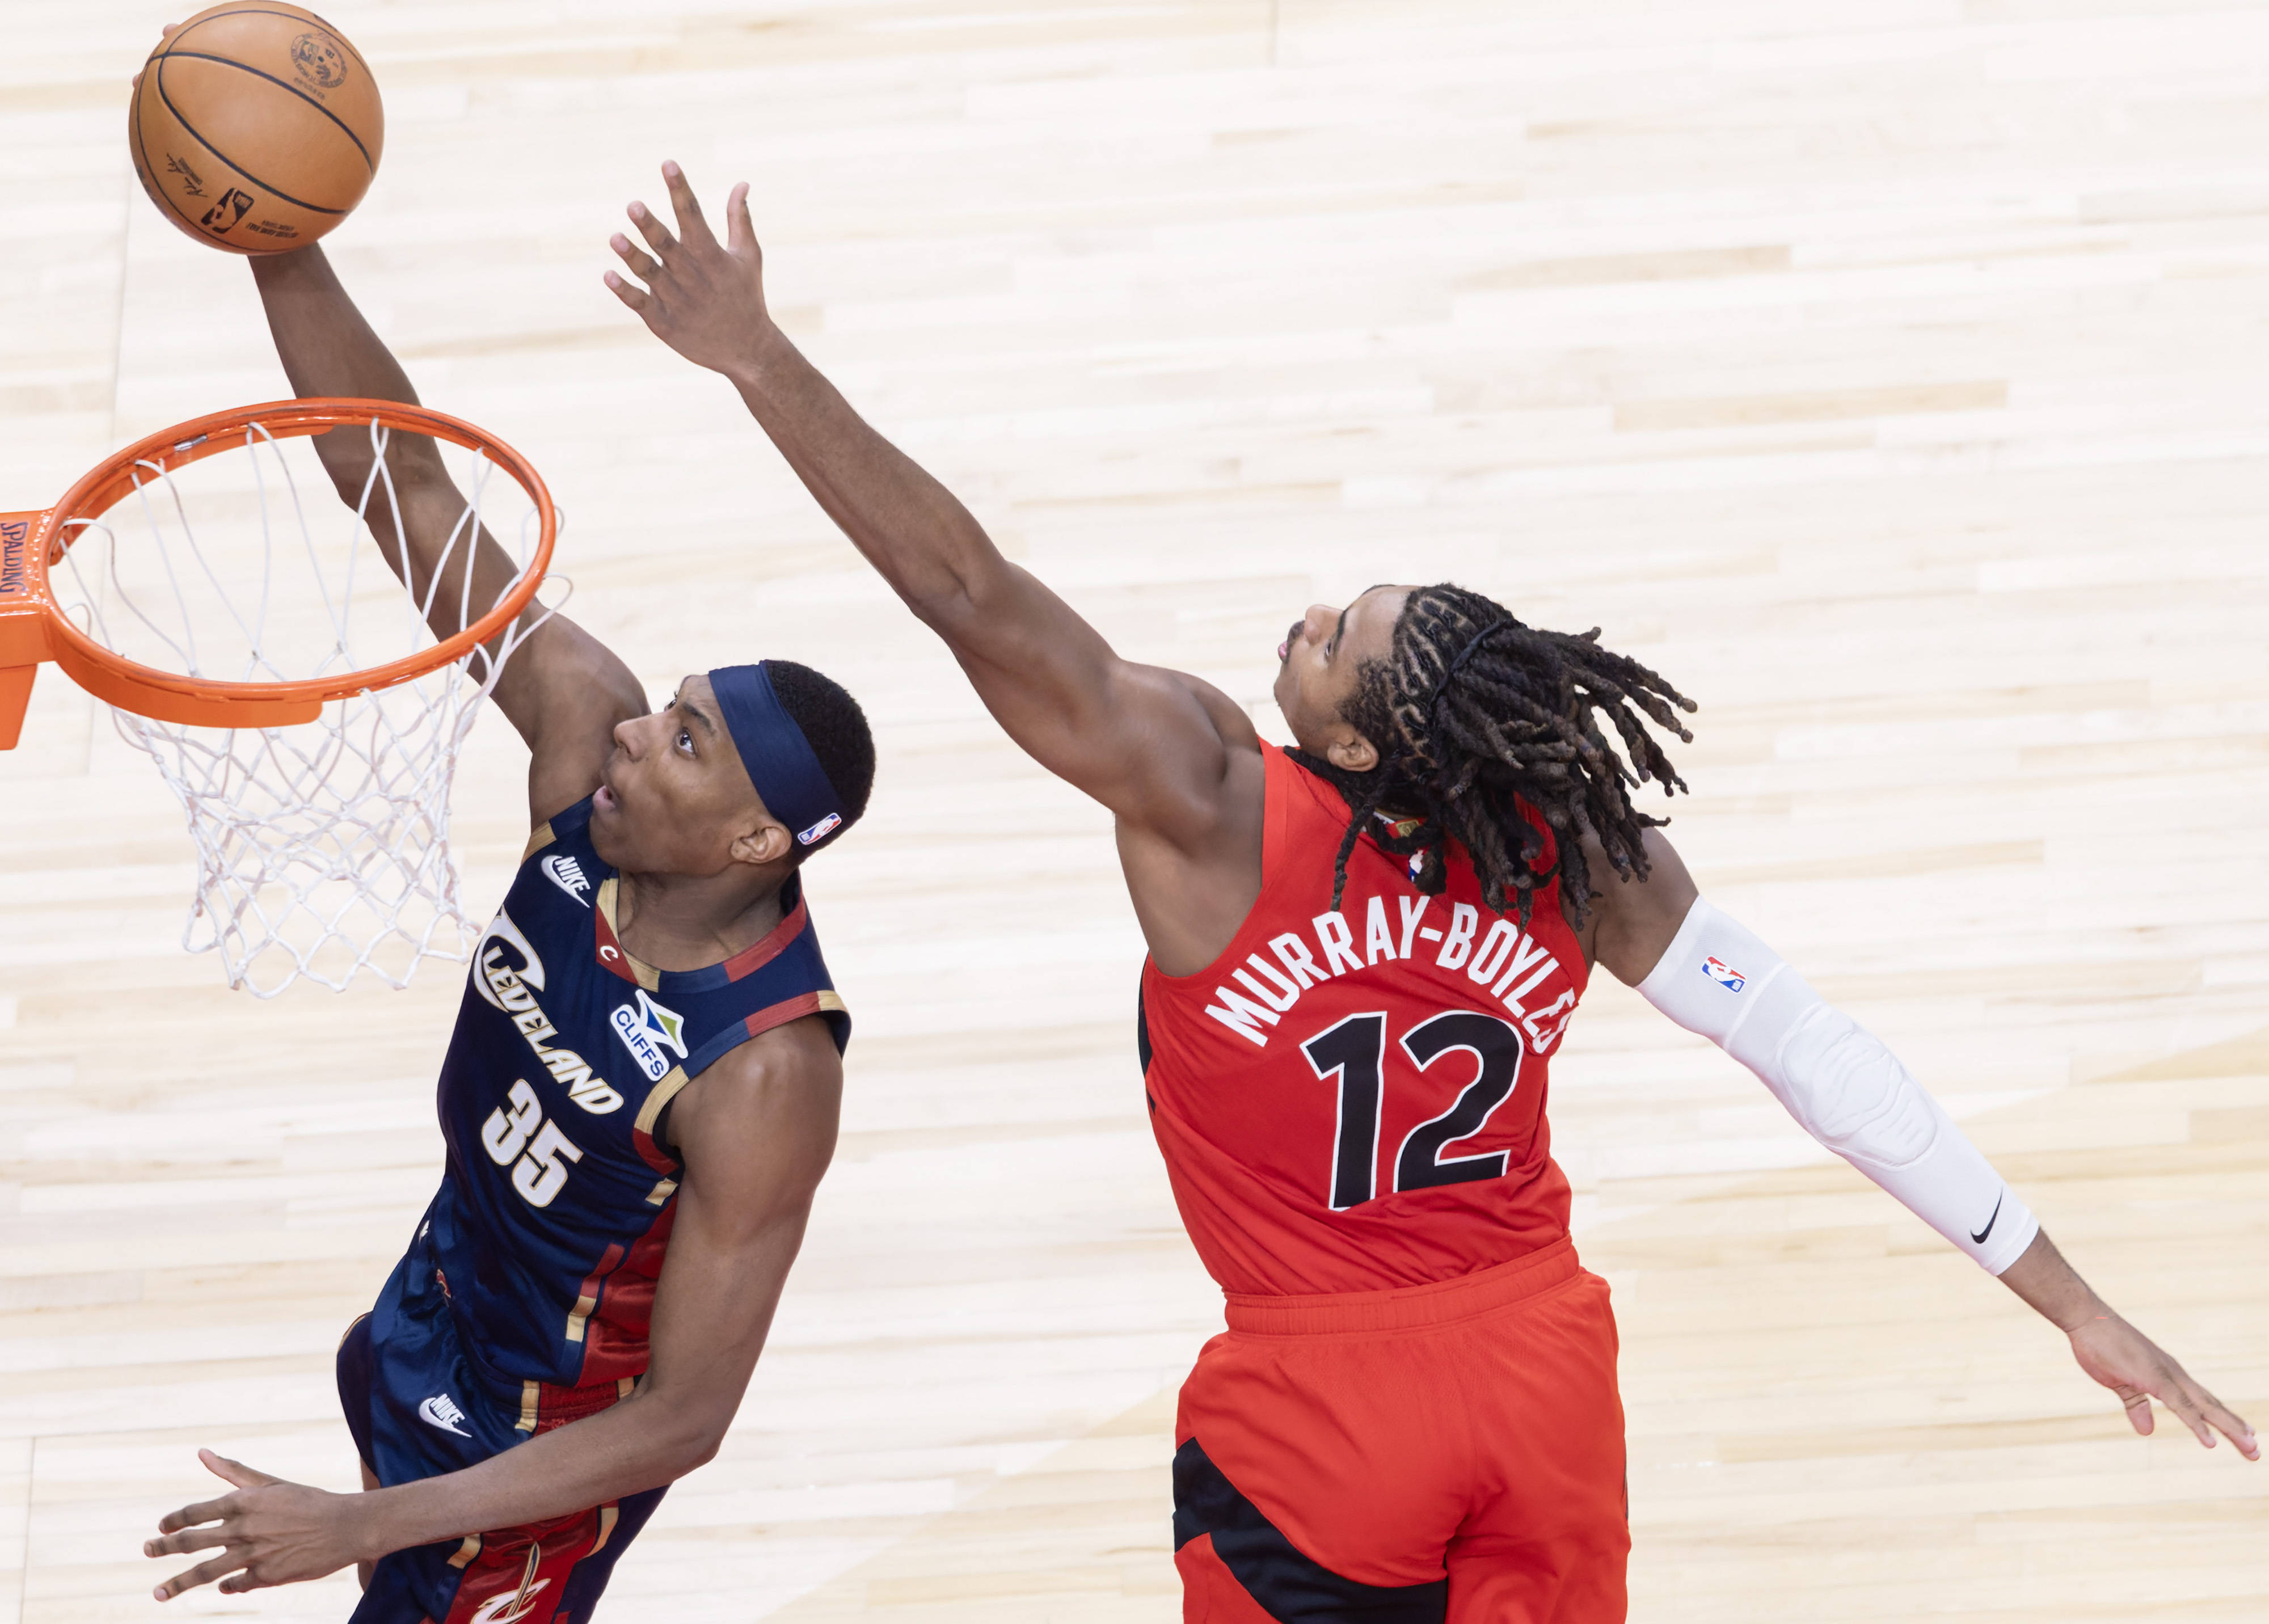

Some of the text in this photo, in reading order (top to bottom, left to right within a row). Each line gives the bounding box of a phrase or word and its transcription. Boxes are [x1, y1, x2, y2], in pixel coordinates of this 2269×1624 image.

[0, 522, 28, 593] SPALDING
[554, 856, 591, 895] NIKE
[600, 945, 619, 961] C
[474, 904, 624, 1115] CLEVELAND
[617, 1010, 664, 1077] CLIFFS
[482, 1078, 583, 1208] 35
[1300, 1010, 1524, 1212] 12
[430, 1393, 466, 1427] NIKE
